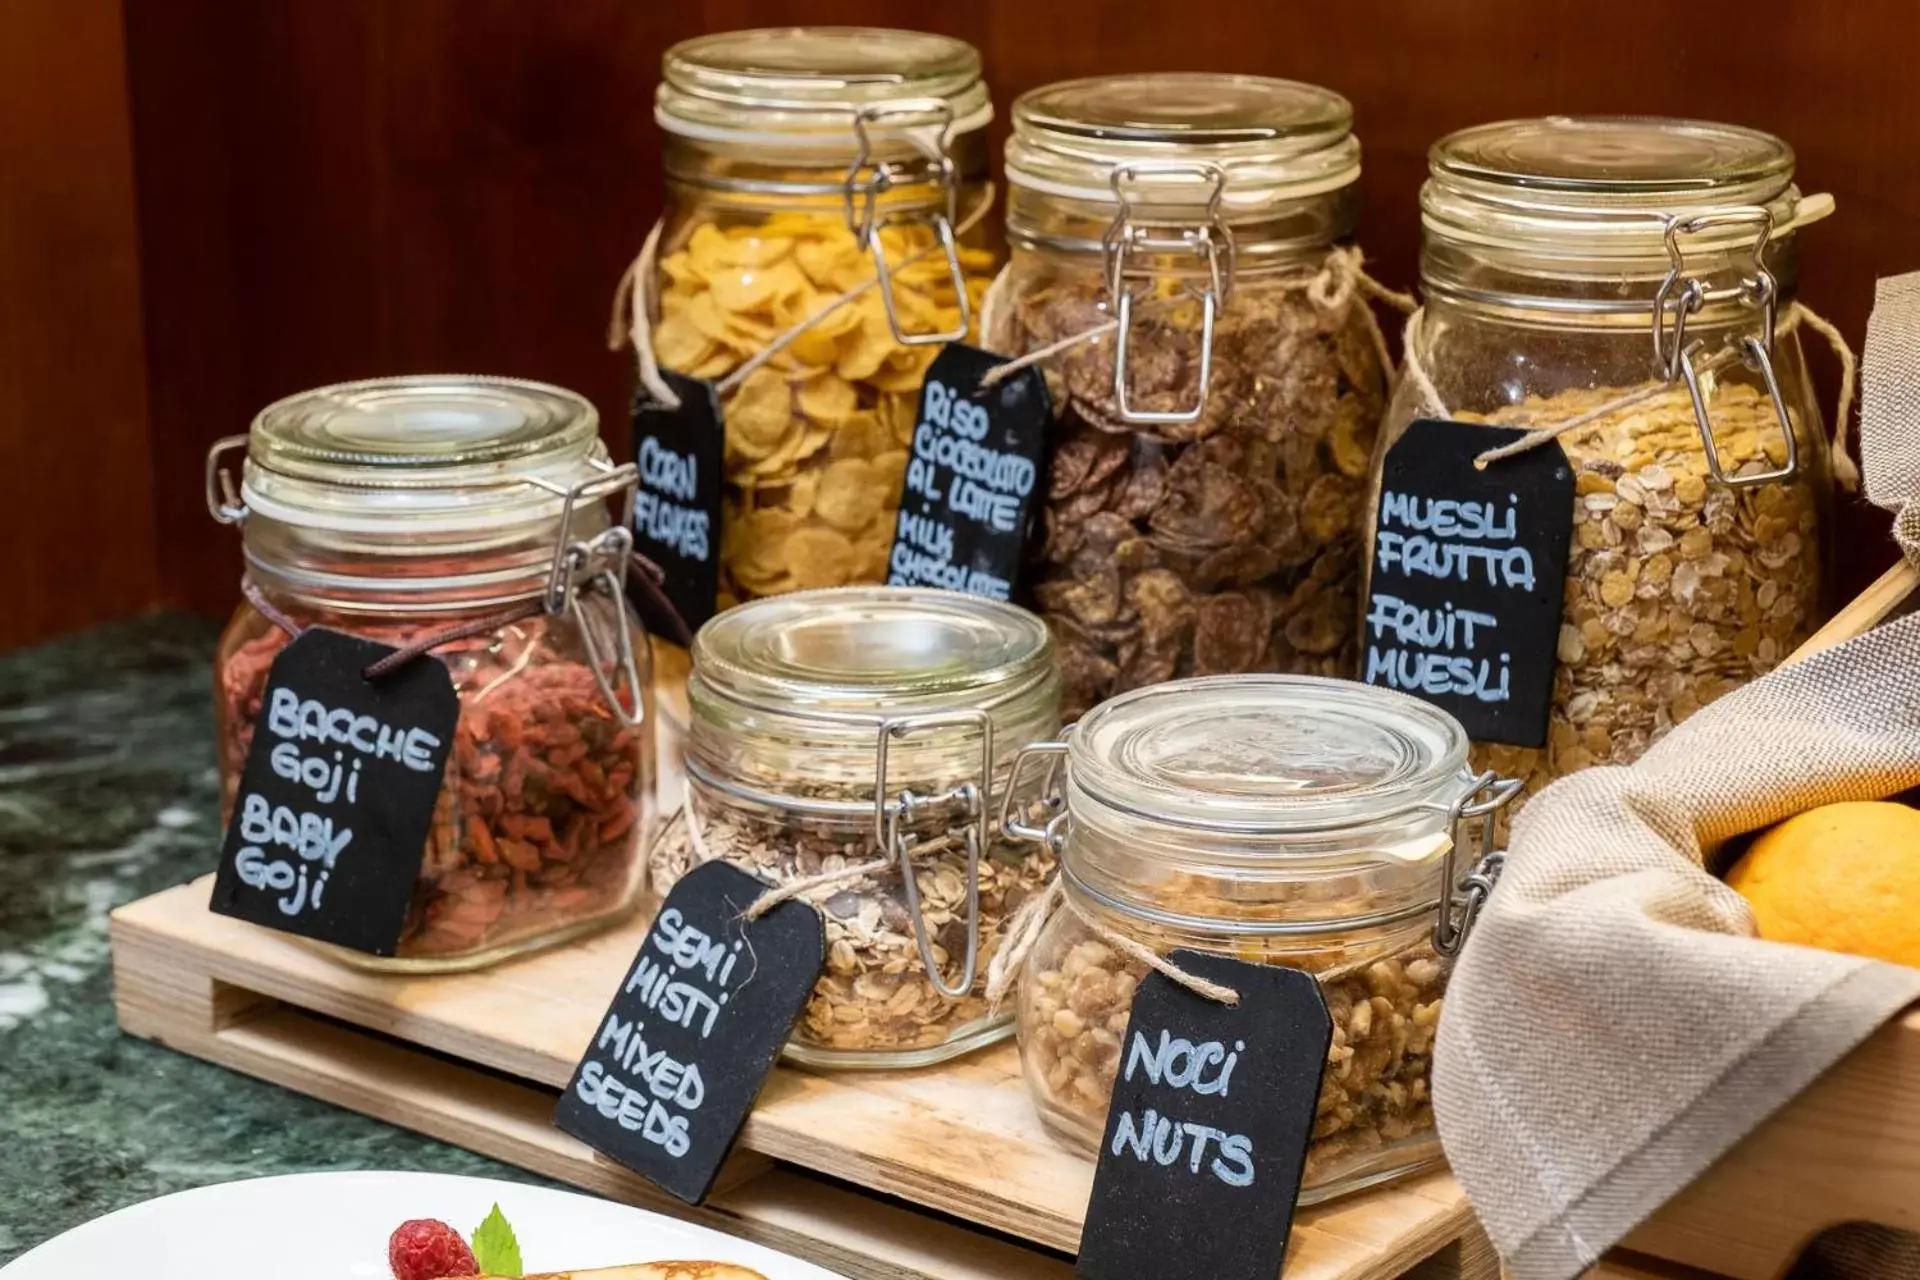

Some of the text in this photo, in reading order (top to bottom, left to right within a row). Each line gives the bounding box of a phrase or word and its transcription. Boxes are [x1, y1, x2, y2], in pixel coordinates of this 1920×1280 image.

[638, 435, 697, 500] CORN
[907, 457, 1020, 532] AL LATTE
[634, 488, 709, 561] FLAKES
[1377, 531, 1536, 592] FRUTTA
[268, 687, 441, 772] BACCHE
[240, 793, 353, 869] BABY
[576, 1060, 691, 1158] SEEDS
[1111, 1108, 1255, 1187] NUTS
